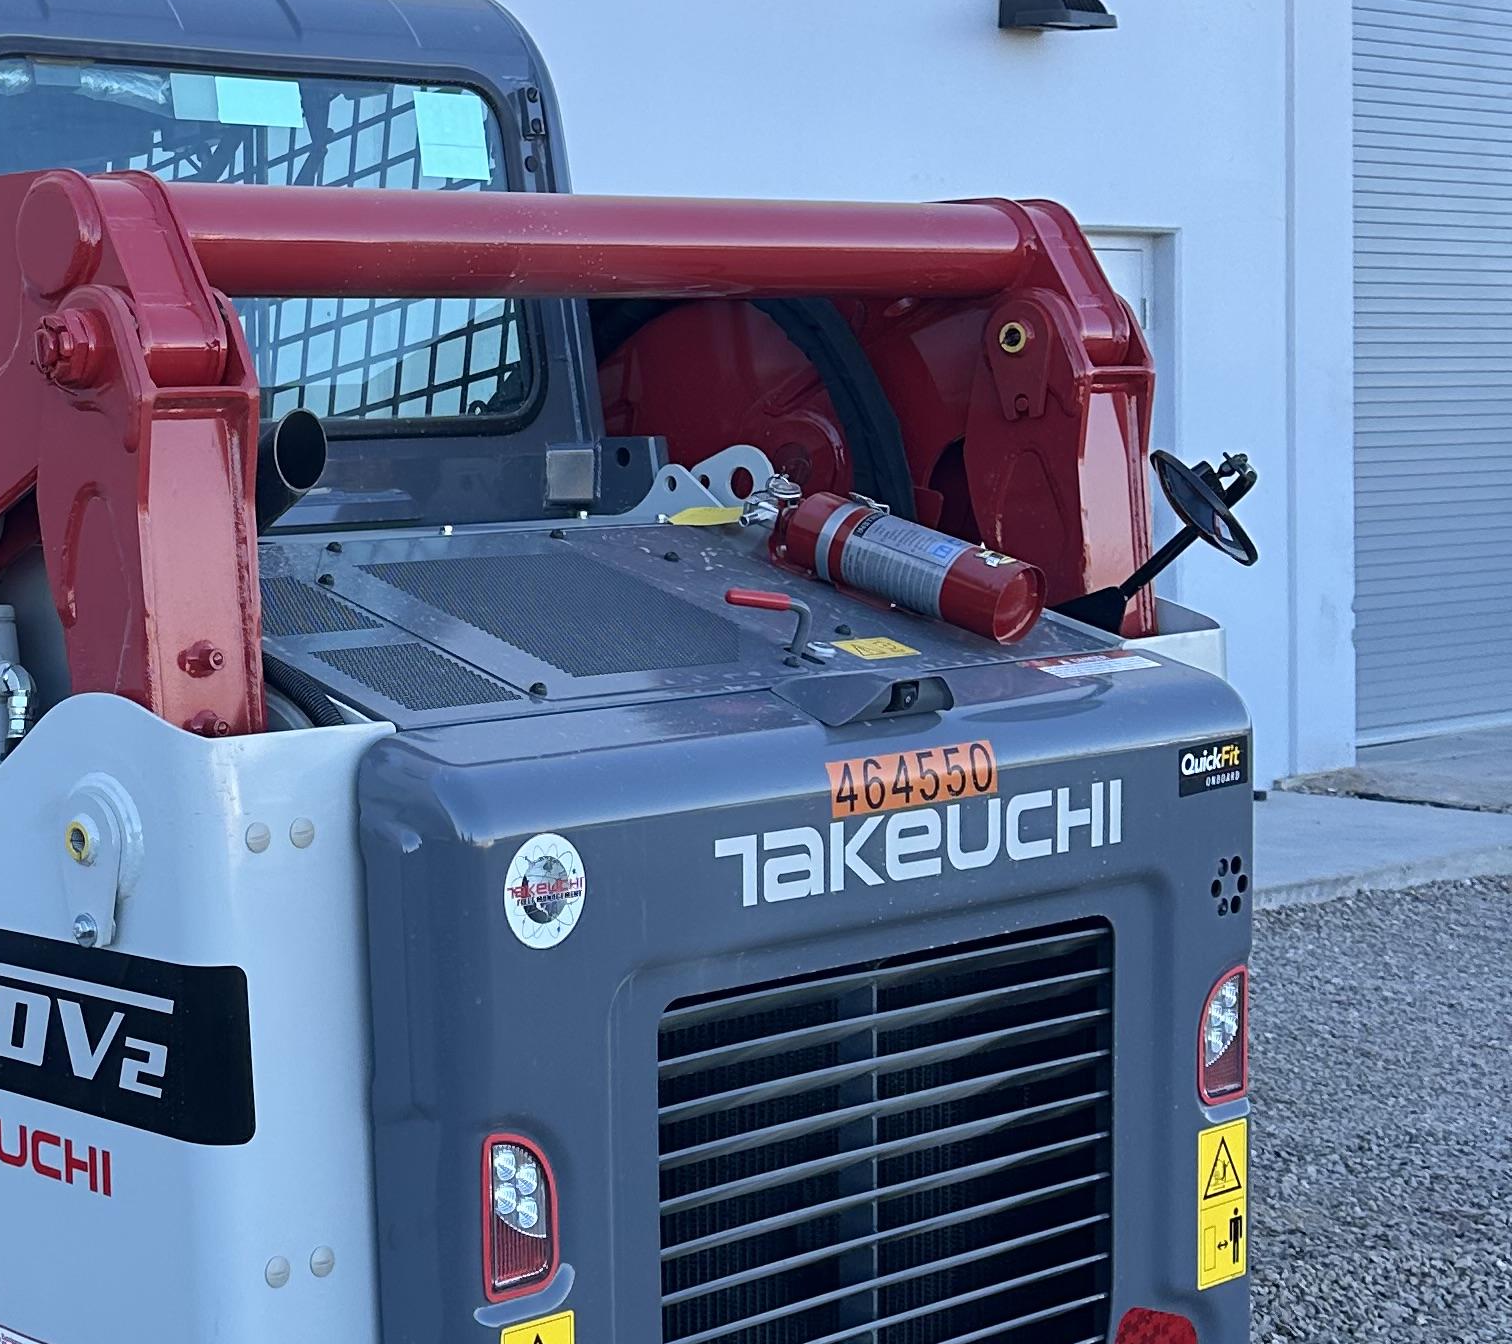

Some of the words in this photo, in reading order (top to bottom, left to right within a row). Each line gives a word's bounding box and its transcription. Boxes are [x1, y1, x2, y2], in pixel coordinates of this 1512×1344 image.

[1181, 744, 1240, 775] QuickFit
[835, 743, 993, 812] 464550
[1205, 770, 1240, 787] ONBOARD
